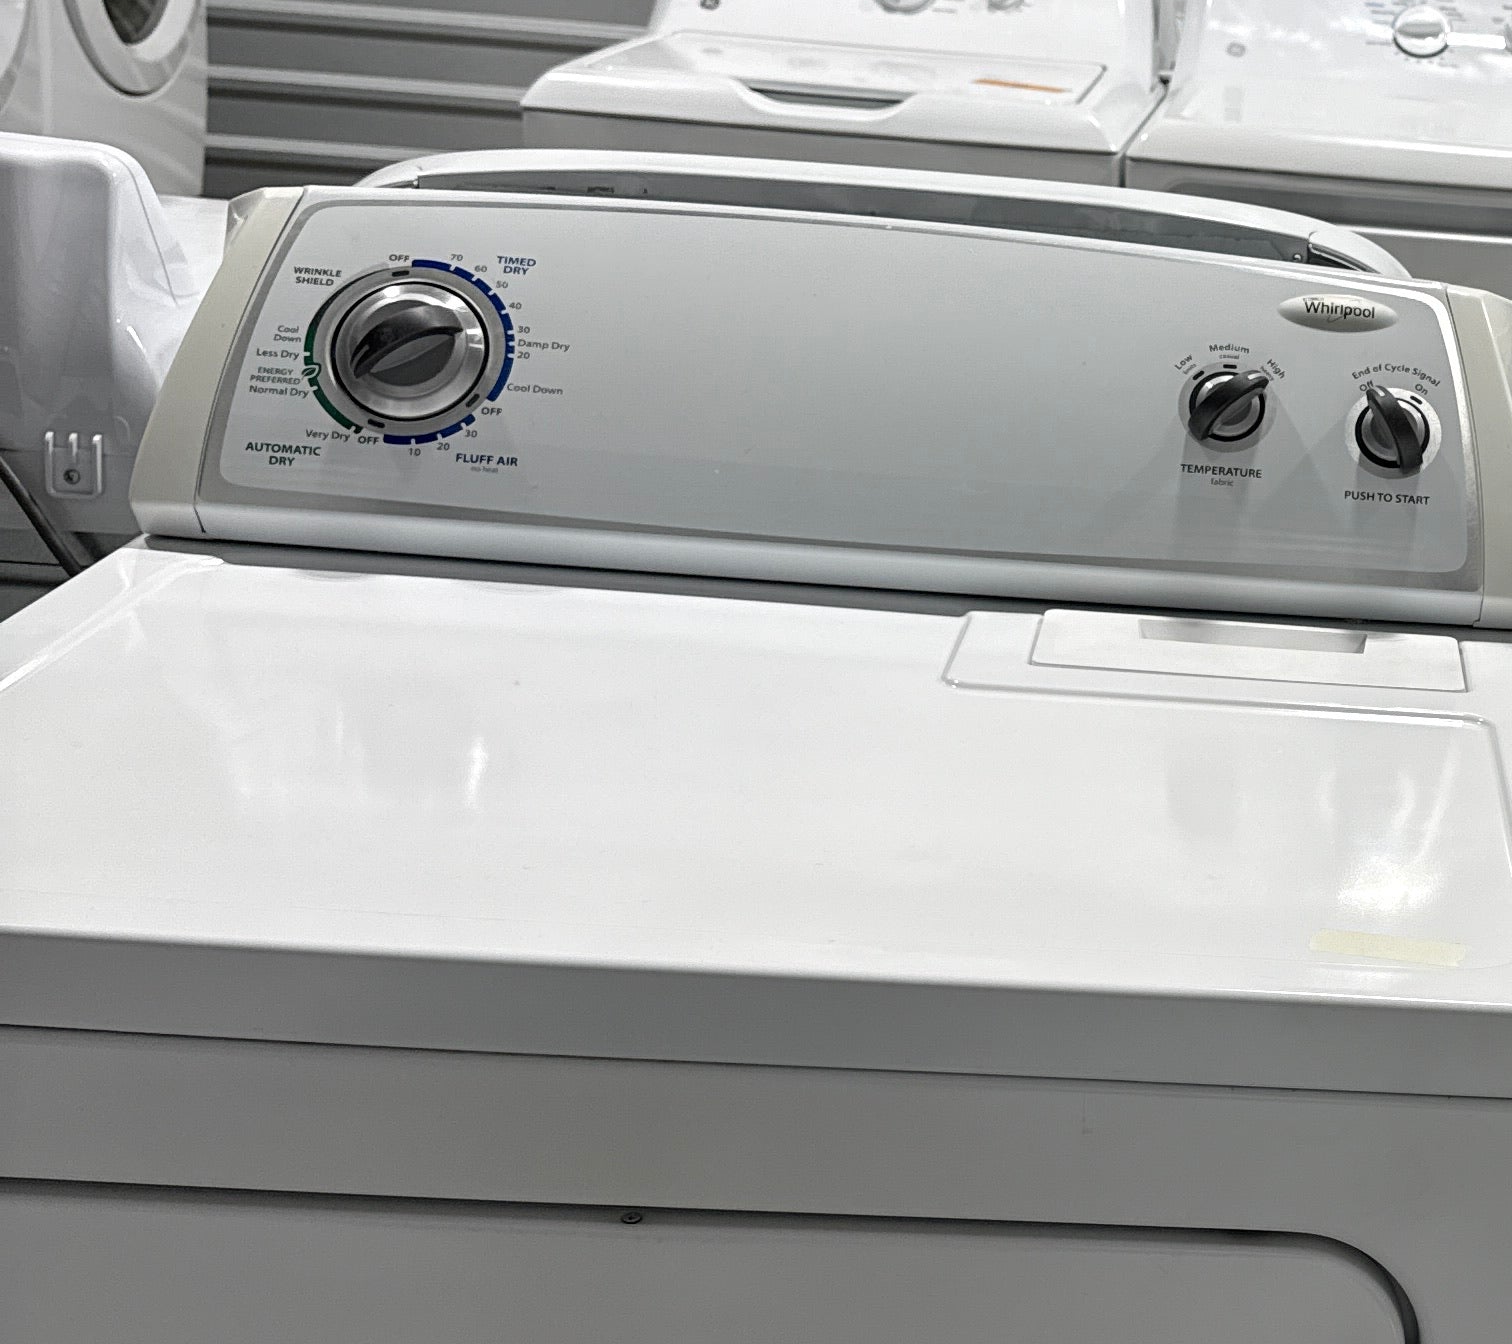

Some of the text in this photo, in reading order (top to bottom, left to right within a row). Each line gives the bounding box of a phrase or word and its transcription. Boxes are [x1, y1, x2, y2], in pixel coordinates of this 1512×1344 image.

[388, 253, 410, 263] OFF
[451, 253, 464, 262] 70
[497, 255, 537, 267] TIMED
[293, 266, 342, 278] WRINKLE
[474, 265, 488, 273] 60
[503, 266, 530, 276] DRY
[295, 276, 334, 287] SHIELD
[496, 280, 509, 289] 50
[508, 302, 522, 310] 40
[1305, 301, 1375, 320] Whirlpool
[277, 324, 299, 334] Cool
[517, 325, 530, 334] 30
[273, 333, 302, 343] Down
[517, 339, 571, 352] Damp Dry
[1208, 343, 1250, 354] Medium
[256, 348, 300, 361] Less Dry
[517, 351, 530, 360] 20
[1174, 354, 1194, 370] Low
[257, 366, 294, 376] ENERGY
[1266, 358, 1286, 379] High
[250, 374, 301, 385] PREFERRED
[1352, 363, 1440, 387] End of Cycle Signal
[507, 383, 564, 396] Cool Down
[1359, 380, 1374, 391] Off
[1414, 383, 1428, 395] On
[249, 385, 310, 399] Normal Dry
[481, 407, 503, 416] OFF
[305, 428, 351, 443] Very Dry
[465, 429, 478, 438] 30
[357, 435, 380, 445] OFF
[245, 441, 322, 456] AUTOMATIC
[409, 447, 421, 457] 10
[436, 442, 450, 451] 20
[268, 455, 295, 467] DRY
[455, 452, 518, 467] FLUFF AIR
[1180, 463, 1263, 479] TEMPERATURE
[1344, 490, 1430, 505] PUSH TO START
